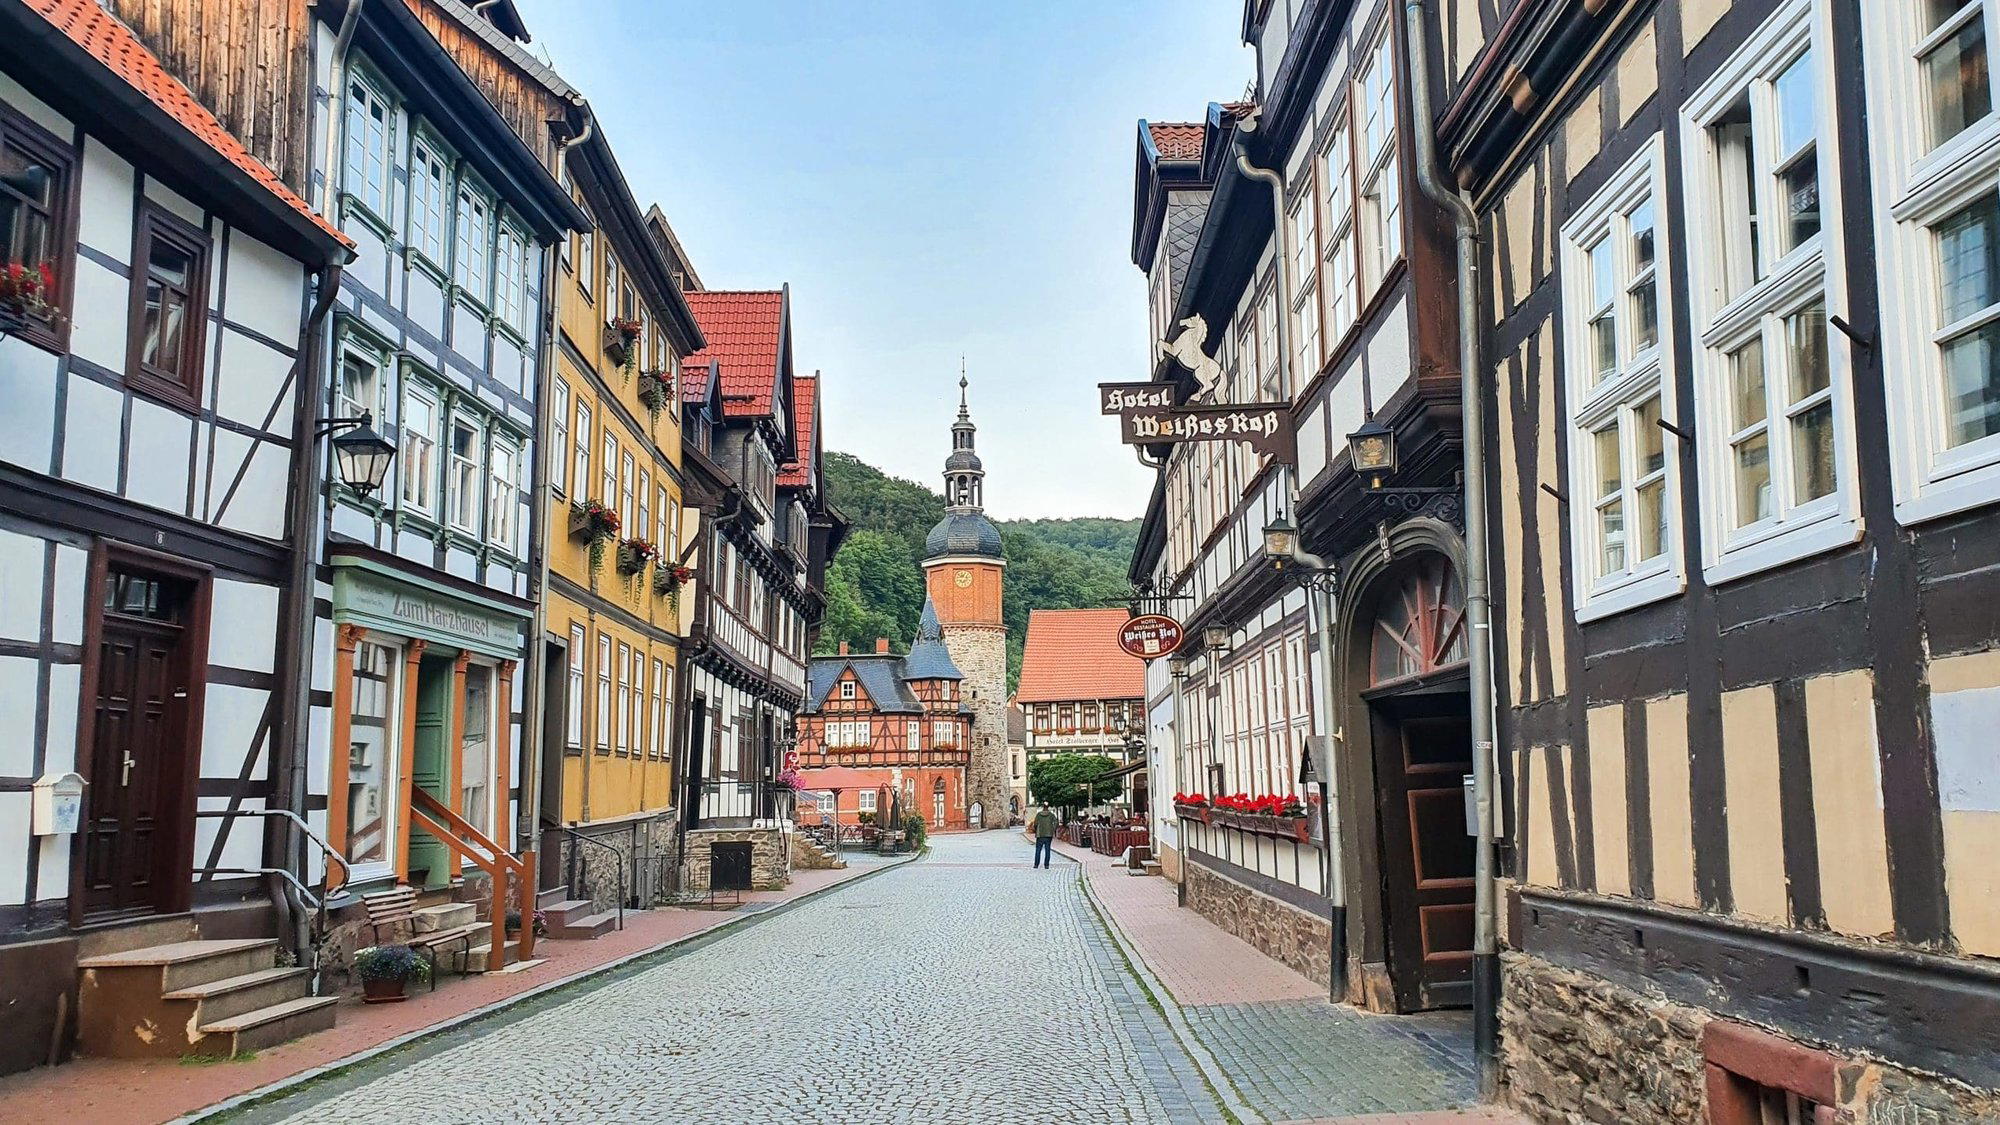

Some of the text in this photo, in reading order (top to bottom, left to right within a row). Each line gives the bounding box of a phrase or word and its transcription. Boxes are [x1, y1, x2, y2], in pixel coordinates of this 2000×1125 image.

[1105, 388, 1170, 410] Hotel
[1132, 410, 1279, 438] Weißes Roß
[393, 592, 423, 621] Zum
[1133, 622, 1166, 631] RESTAURANT
